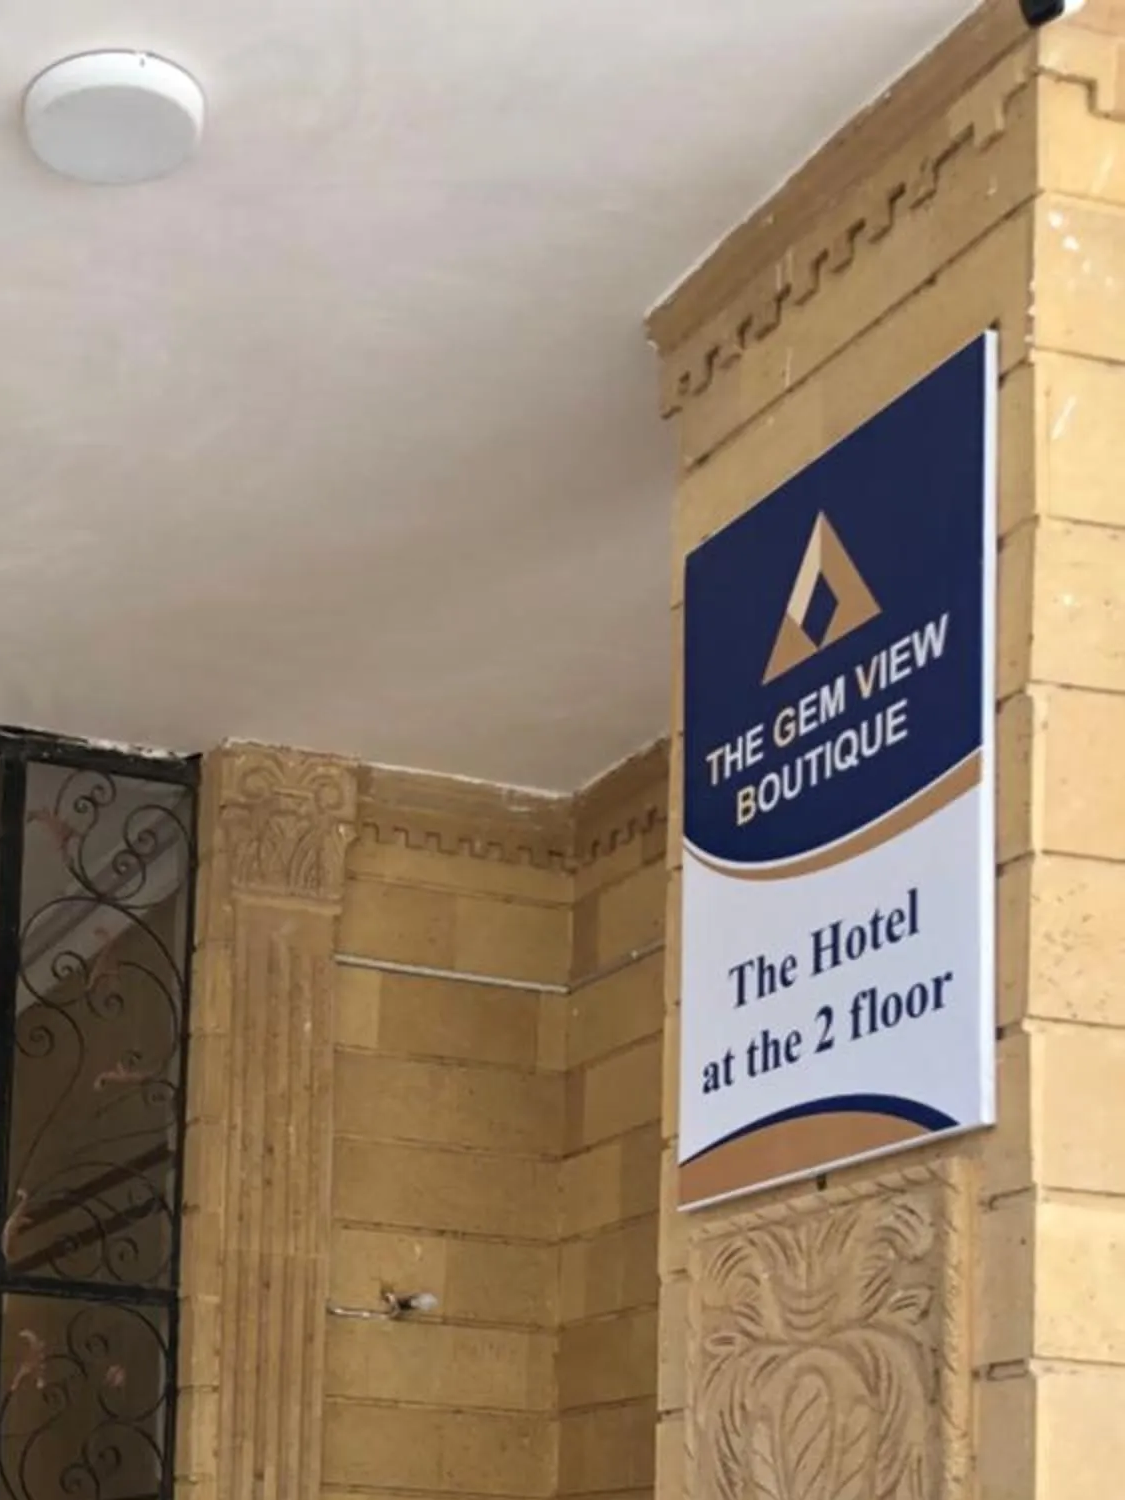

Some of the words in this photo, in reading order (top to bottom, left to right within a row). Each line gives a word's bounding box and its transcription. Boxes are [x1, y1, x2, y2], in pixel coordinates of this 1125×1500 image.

[705, 722, 764, 787] THE
[773, 674, 846, 747] GEM
[855, 612, 950, 699] VIEW
[735, 700, 909, 826] BOUTIQUE
[727, 954, 798, 1010] The
[810, 886, 920, 976] Hotel
[701, 1048, 735, 1095] at
[746, 1027, 802, 1078] the
[813, 1004, 836, 1055] 2
[848, 970, 954, 1041] floor
